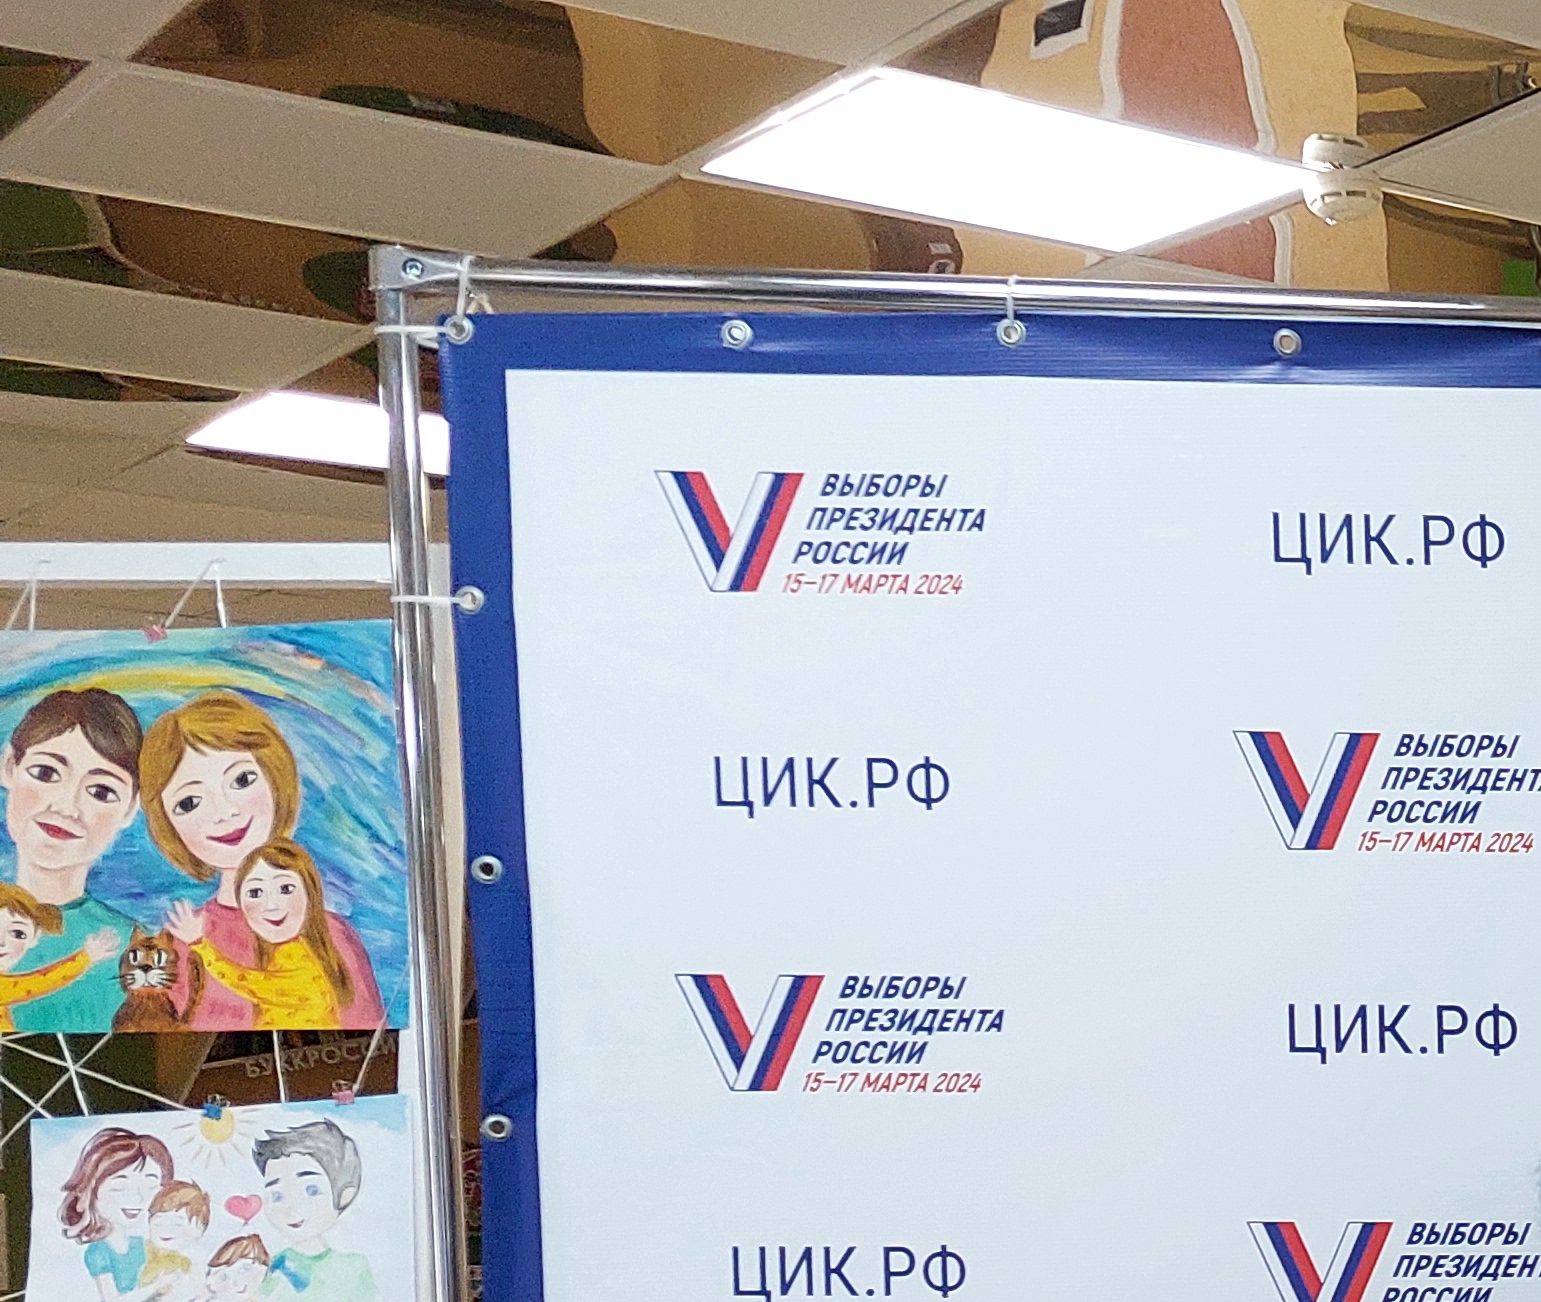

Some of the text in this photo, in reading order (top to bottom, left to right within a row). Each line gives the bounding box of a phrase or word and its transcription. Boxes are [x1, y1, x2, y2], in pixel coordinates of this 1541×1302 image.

[819, 473, 949, 498] ВЫБОРЫ
[806, 506, 987, 536] ПРЕЗИДЕНТА
[791, 540, 910, 566] РОССИИ
[1272, 511, 1505, 576] ЦИК.РФ
[845, 573, 910, 595] МАРТА
[913, 574, 963, 595] 2024
[1393, 733, 1521, 759] ВЫБОРЫ
[713, 755, 950, 819] ЦИК.РФ
[1366, 799, 1483, 824] РОССИИ
[1414, 831, 1483, 853] МАРТА
[1484, 832, 1534, 854] 2024
[838, 975, 968, 1000] ВЫБОРЫ
[824, 1008, 1005, 1036] ПРЕЗИДЕНТА
[1288, 1002, 1518, 1065] ЦИК.РФ
[811, 1040, 929, 1065] РОССИИ
[860, 1072, 929, 1093] МАРТА
[932, 1072, 982, 1093] 2024
[1405, 1222, 1533, 1246] ВЫБОРЫ
